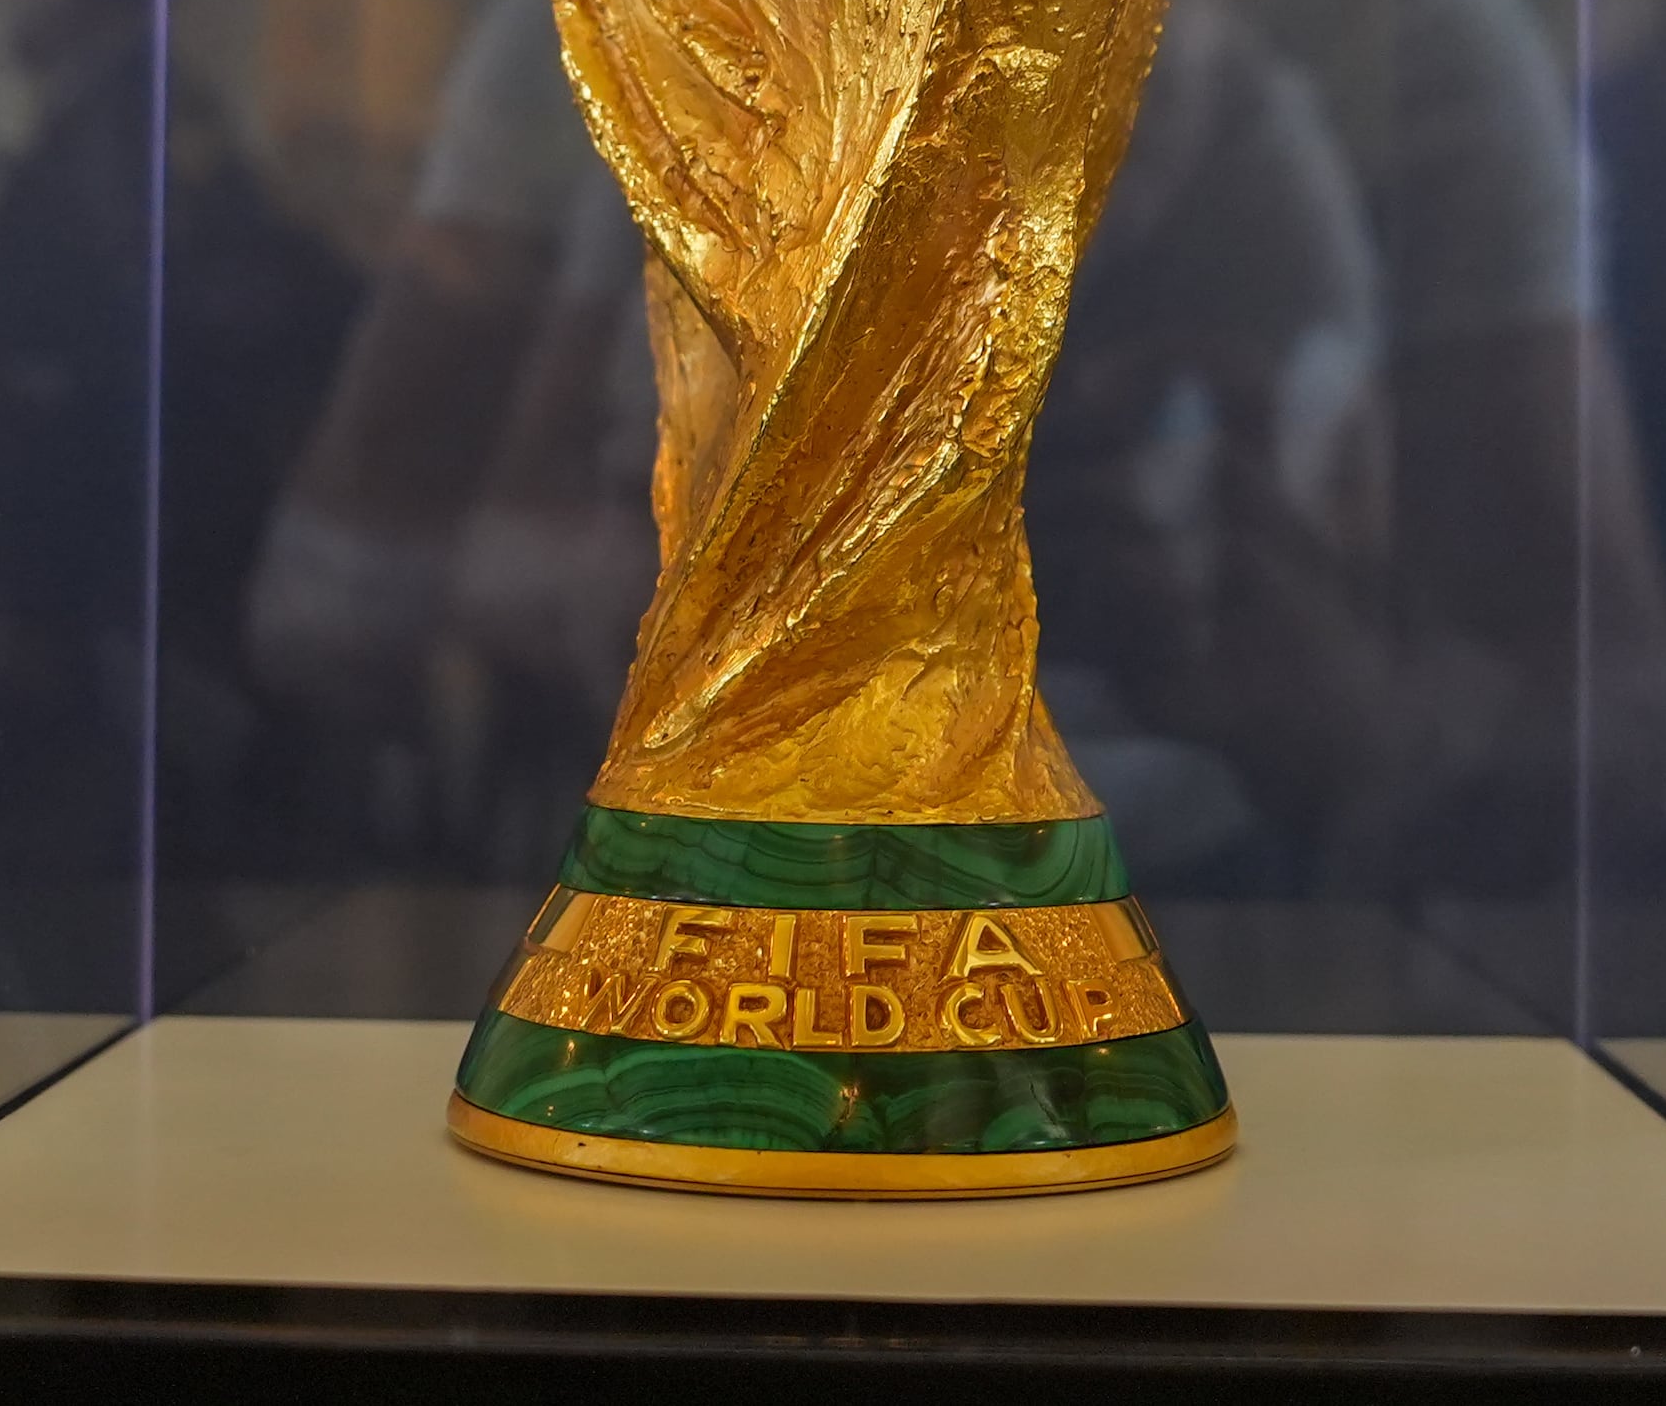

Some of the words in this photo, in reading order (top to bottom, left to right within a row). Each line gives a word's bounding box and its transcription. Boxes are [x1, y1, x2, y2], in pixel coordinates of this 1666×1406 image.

[647, 904, 1045, 981] FIFA
[580, 968, 909, 1050] WORLD
[939, 977, 1120, 1048] CUP
